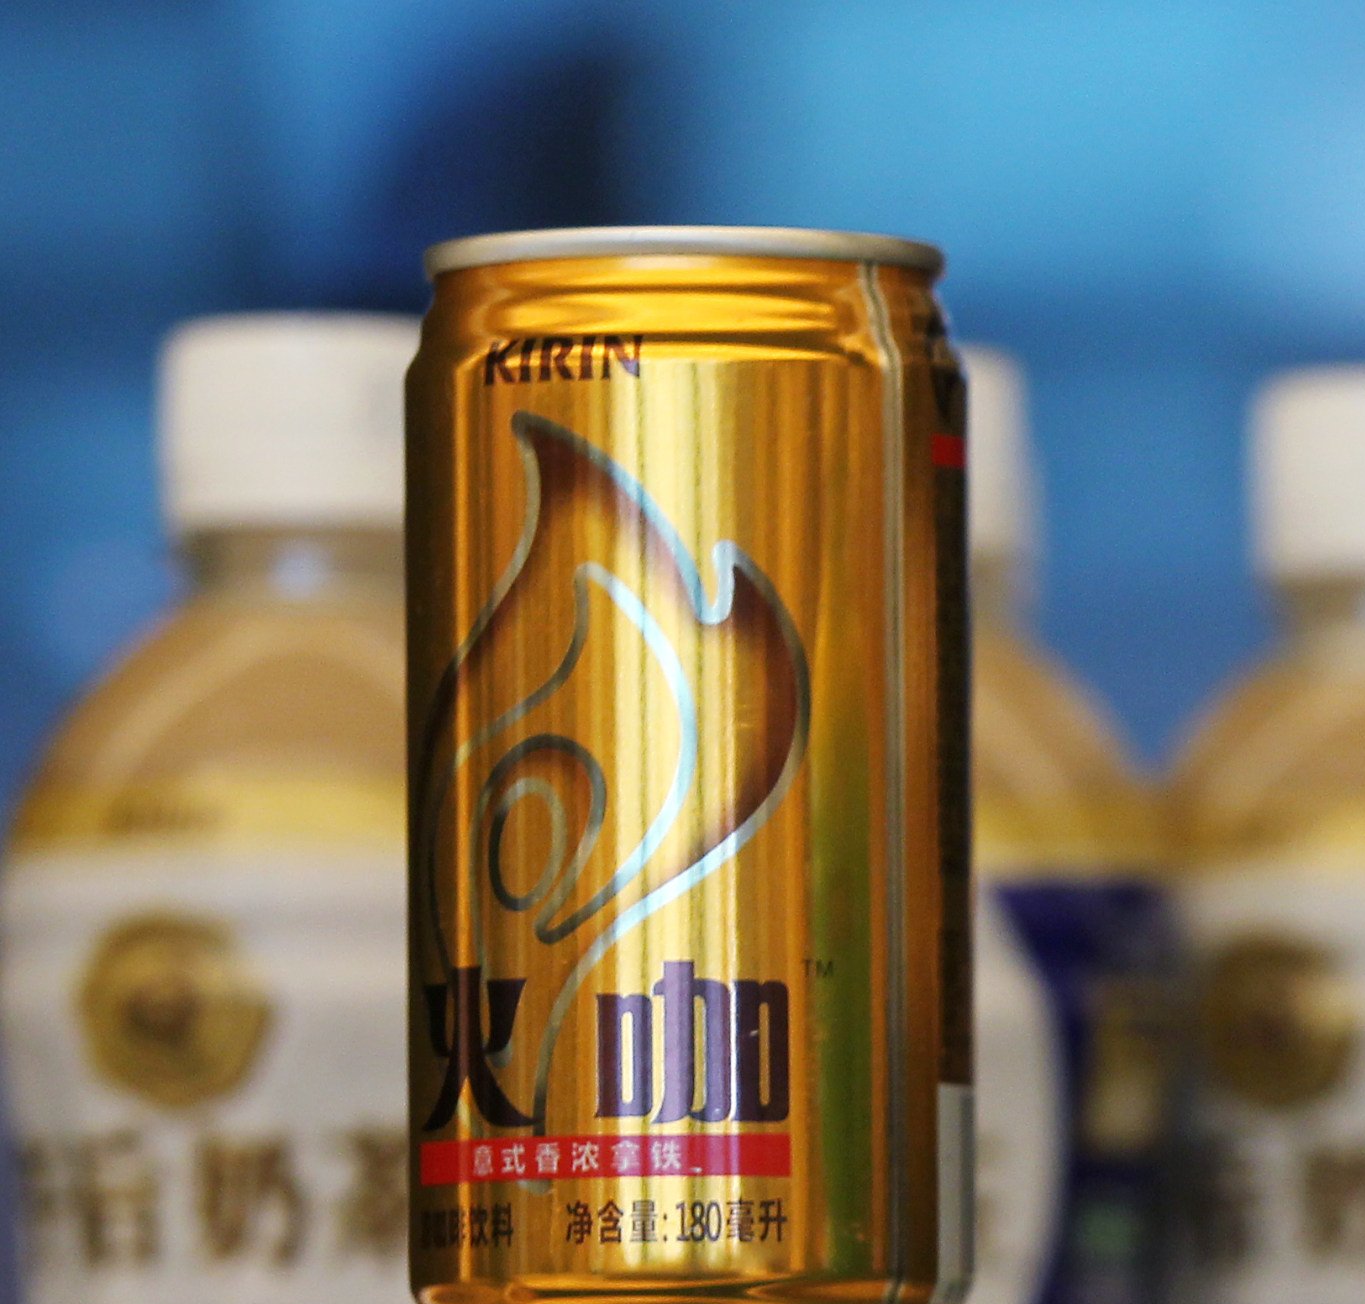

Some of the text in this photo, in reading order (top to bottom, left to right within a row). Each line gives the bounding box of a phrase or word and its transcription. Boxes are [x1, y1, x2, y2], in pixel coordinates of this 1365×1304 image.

[484, 334, 643, 386] KIRIN
[422, 960, 790, 1132] 火咖
[472, 1138, 683, 1178] 意式香浓拿铁
[566, 1197, 787, 1246] 净含量:180毫升
